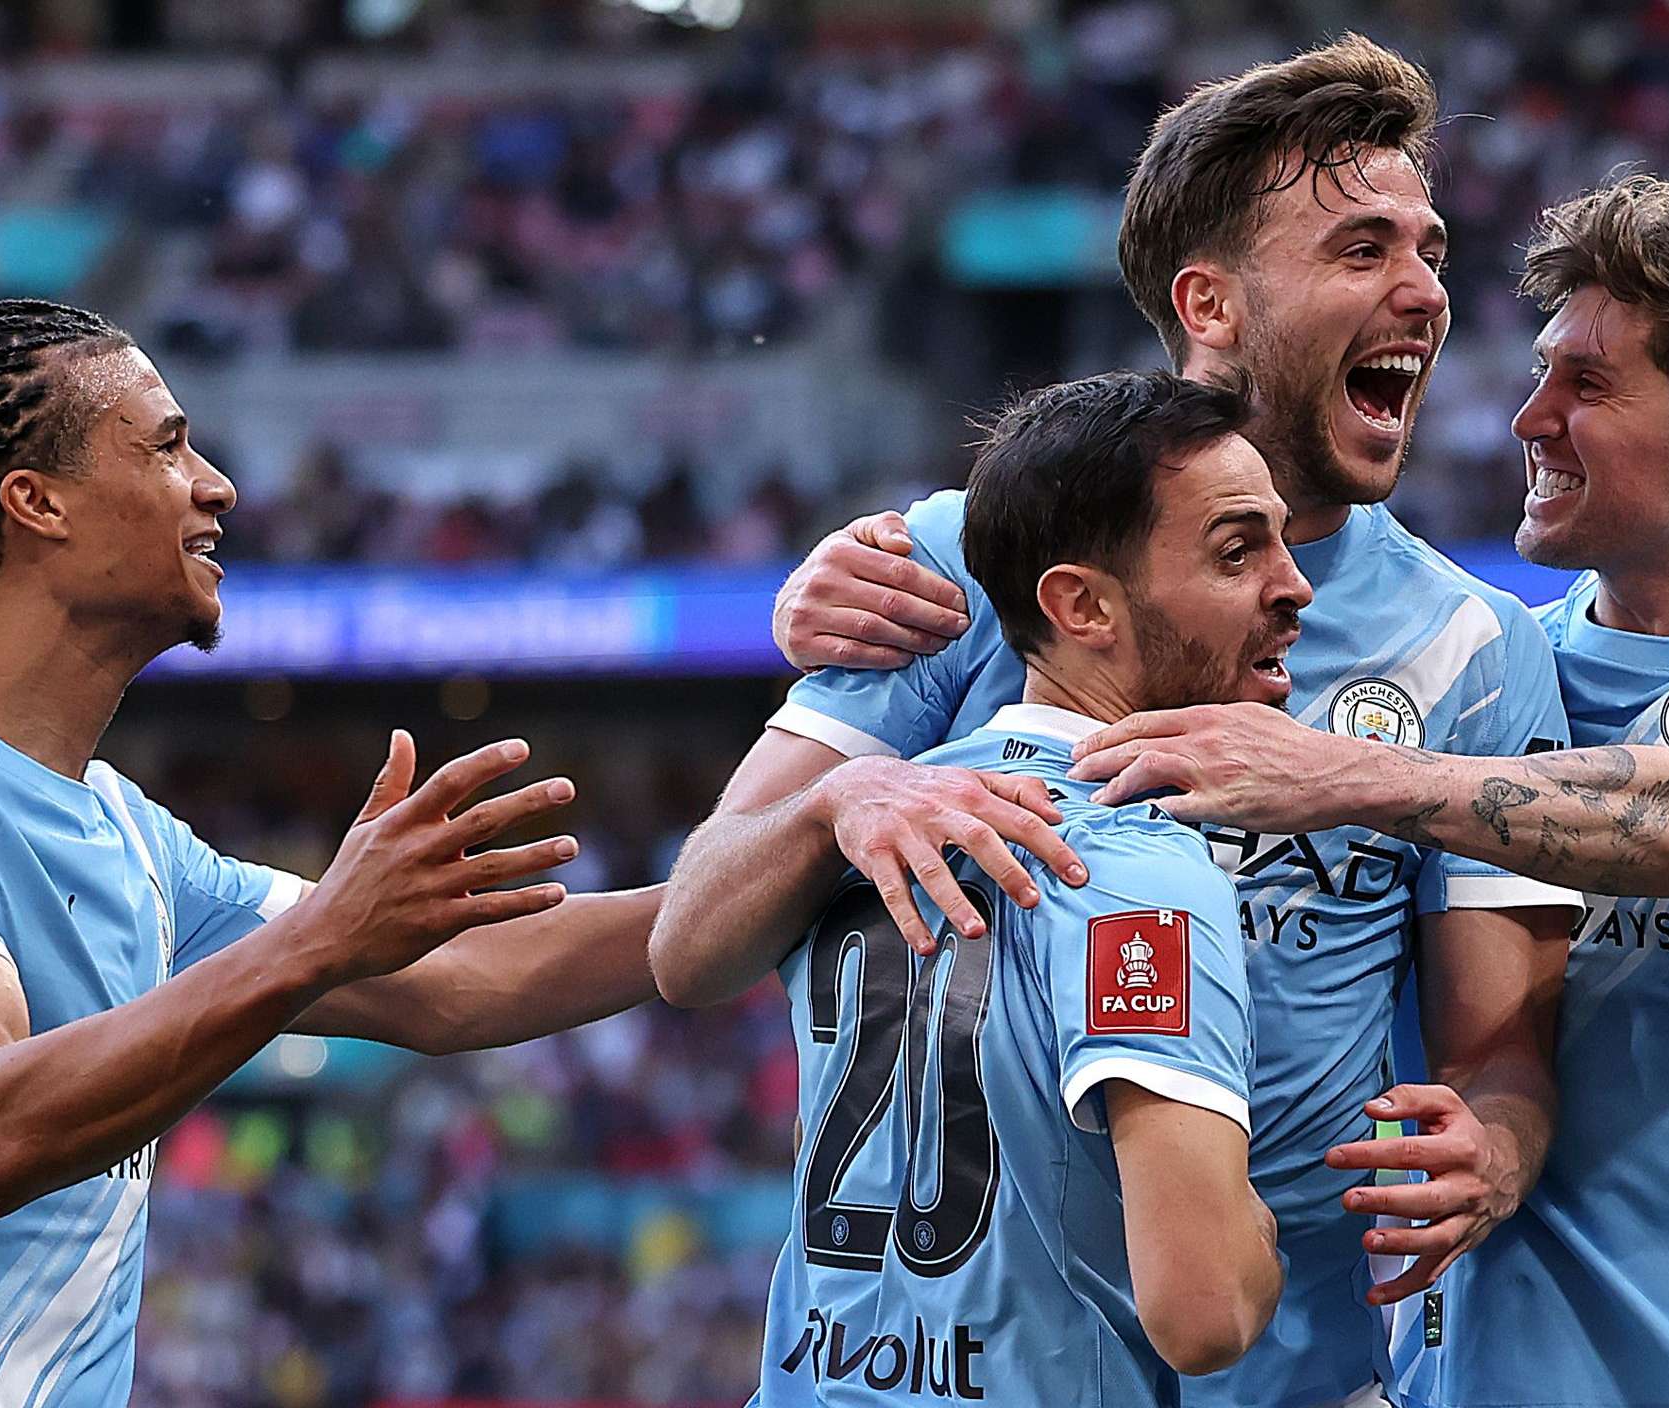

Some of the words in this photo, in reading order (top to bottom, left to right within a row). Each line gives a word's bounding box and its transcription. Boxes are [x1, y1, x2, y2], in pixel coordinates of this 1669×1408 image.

[1342, 685, 1415, 727] MANCHESTER
[1002, 737, 1040, 761] CITY
[1101, 995, 1128, 1013] FA
[1130, 994, 1176, 1013] CUP
[804, 868, 999, 1280] 20
[779, 1307, 985, 1401] Rvolut
